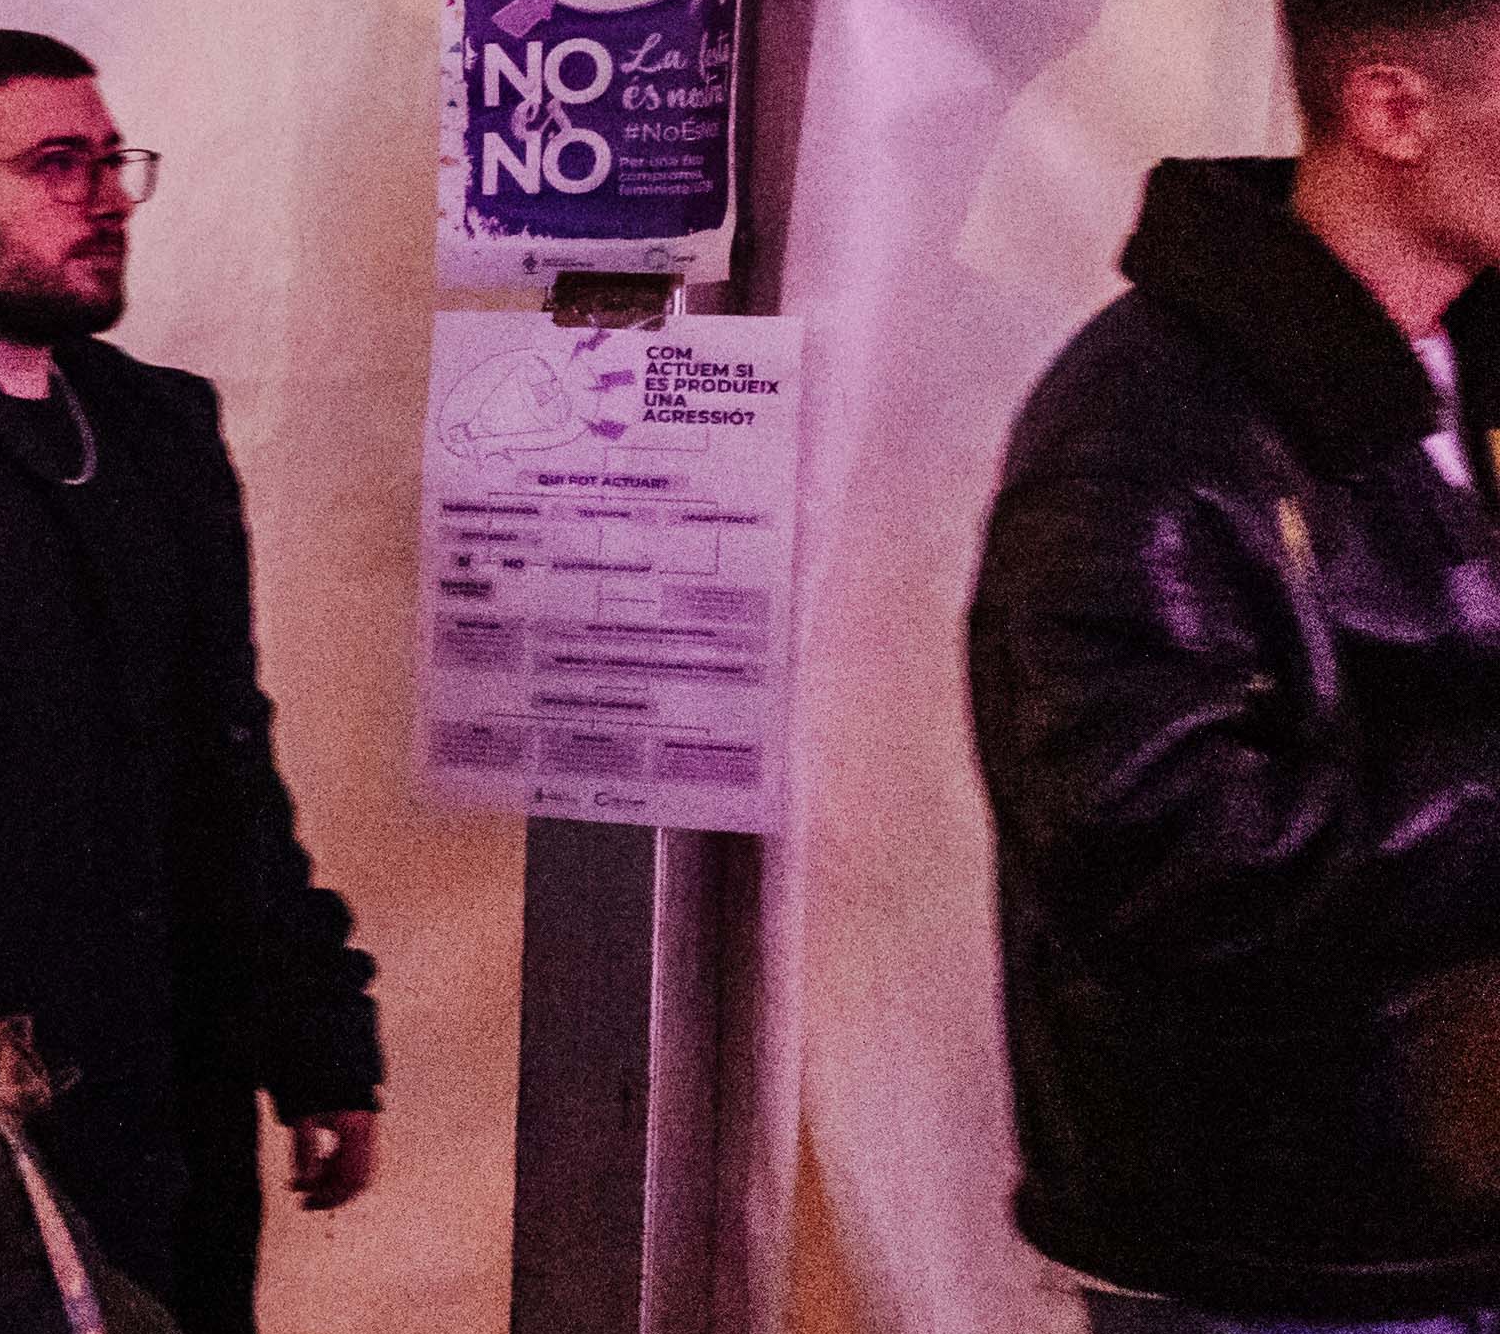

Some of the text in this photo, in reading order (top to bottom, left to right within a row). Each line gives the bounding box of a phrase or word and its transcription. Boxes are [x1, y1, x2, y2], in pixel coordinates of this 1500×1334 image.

[620, 32, 686, 74] La
[483, 37, 613, 107] NO
[622, 76, 661, 112] és
[481, 127, 612, 196] NO
[646, 346, 693, 360] COM
[645, 362, 754, 378] ACTUEM SI
[645, 377, 780, 394] ES PRODUEIX
[643, 393, 687, 407] UNA
[642, 408, 756, 425] AGRESSIÓ?
[538, 473, 670, 489] QUI POT ACTUAR?
[503, 557, 525, 569] NO
